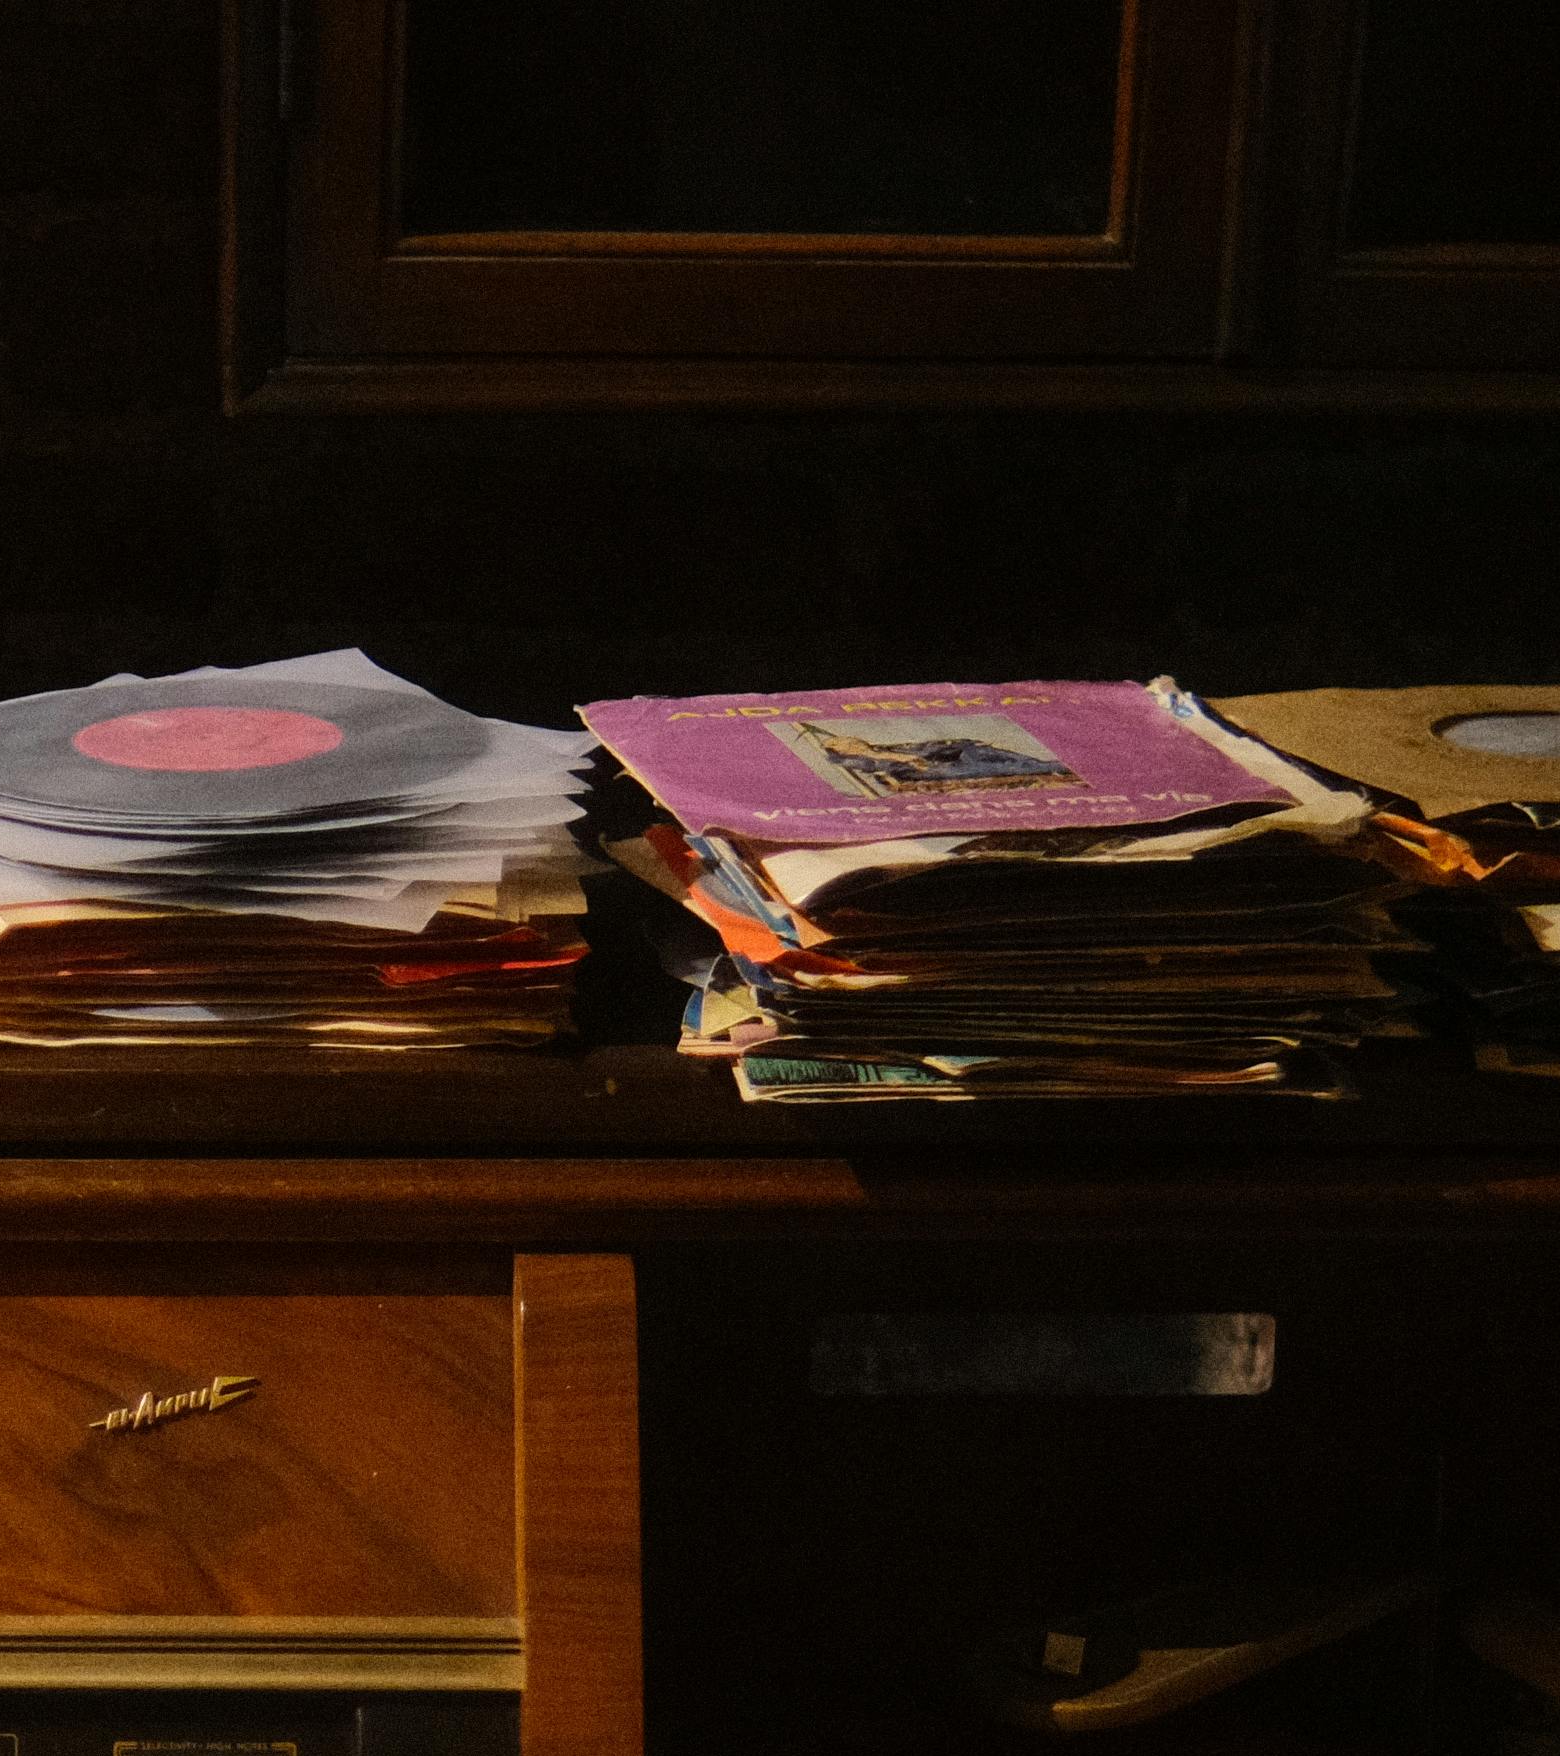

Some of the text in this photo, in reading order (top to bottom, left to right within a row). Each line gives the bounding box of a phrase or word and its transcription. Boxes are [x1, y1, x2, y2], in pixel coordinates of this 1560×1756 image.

[667, 705, 823, 721] AJDA
[1047, 793, 1129, 806] ma
[1142, 790, 1213, 803] vie
